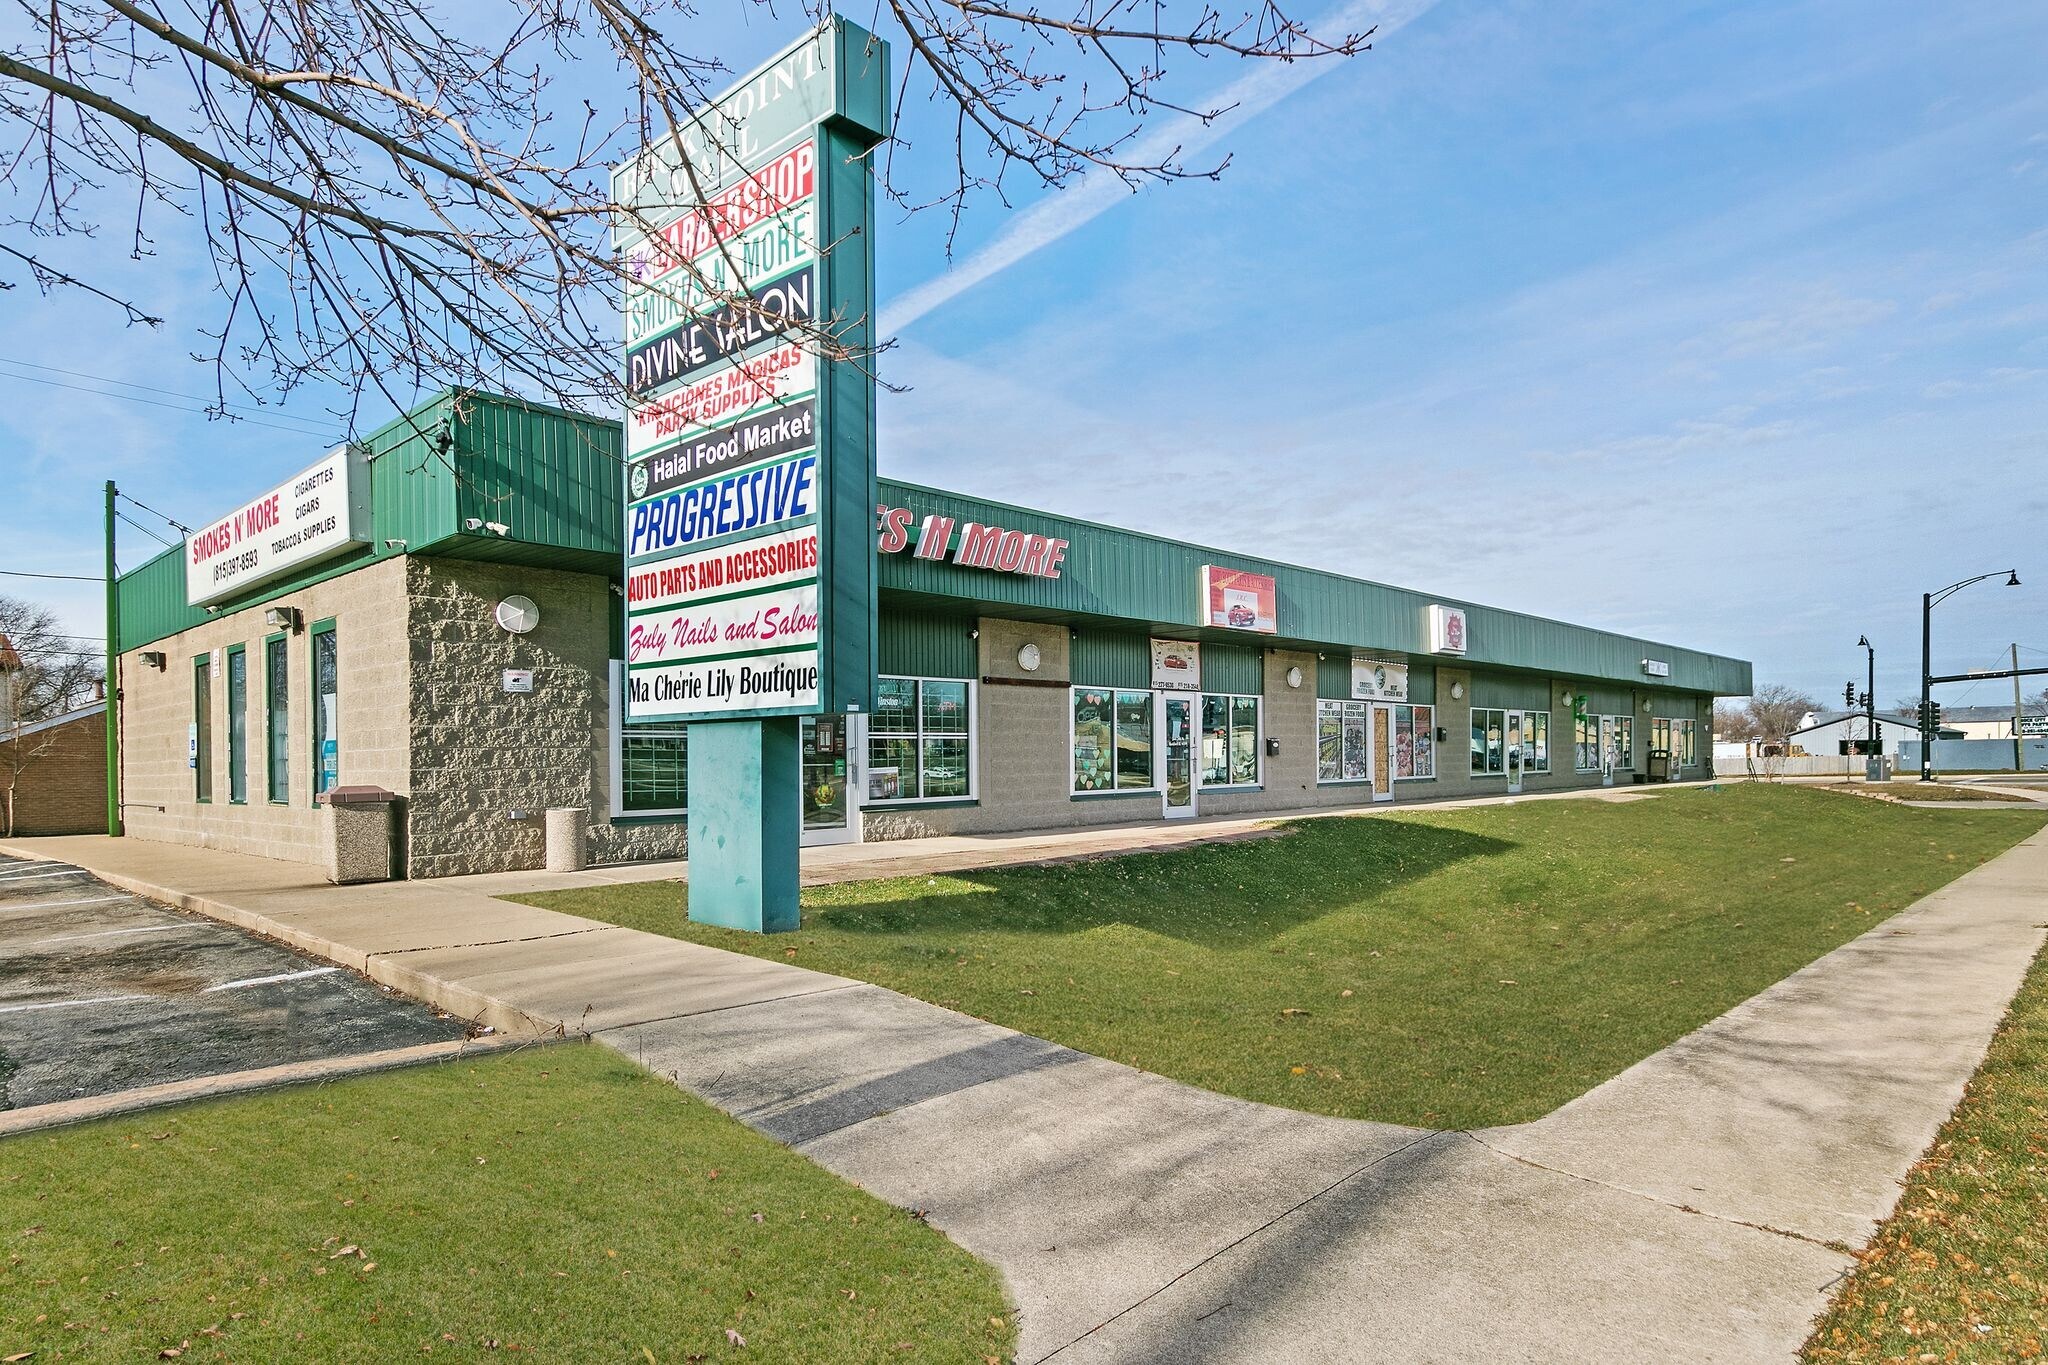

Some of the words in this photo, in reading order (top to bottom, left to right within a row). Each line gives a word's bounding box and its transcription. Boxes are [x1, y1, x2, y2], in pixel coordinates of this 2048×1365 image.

[713, 41, 820, 138] POINT
[632, 268, 704, 339] SMOKES
[743, 213, 807, 283] MORE
[632, 322, 707, 393] DIVINE
[727, 344, 802, 391] MAGICAS
[703, 376, 776, 420] SUPPLIES
[654, 452, 691, 483] Halal
[695, 432, 739, 469] Food
[743, 410, 811, 453] Market
[294, 467, 334, 498] CIGARETTES
[295, 497, 320, 520] CIGARS
[630, 456, 817, 555] PROGRESSIVE
[193, 521, 231, 565] SMOKES
[246, 494, 279, 538] MORE
[303, 516, 336, 541] SUPPLIES
[919, 515, 955, 561] N
[955, 522, 1069, 579] MORE
[629, 571, 657, 602] AUTO
[660, 563, 696, 597] PARTS
[699, 558, 722, 590] AND
[726, 536, 817, 585] ACCESSORIES
[630, 624, 667, 662] Zuly
[672, 616, 718, 648] Nails
[724, 610, 760, 642] and
[760, 604, 817, 640] Salon
[629, 677, 649, 703] Ma
[707, 668, 735, 703] Lily
[739, 662, 818, 698] Boutique
